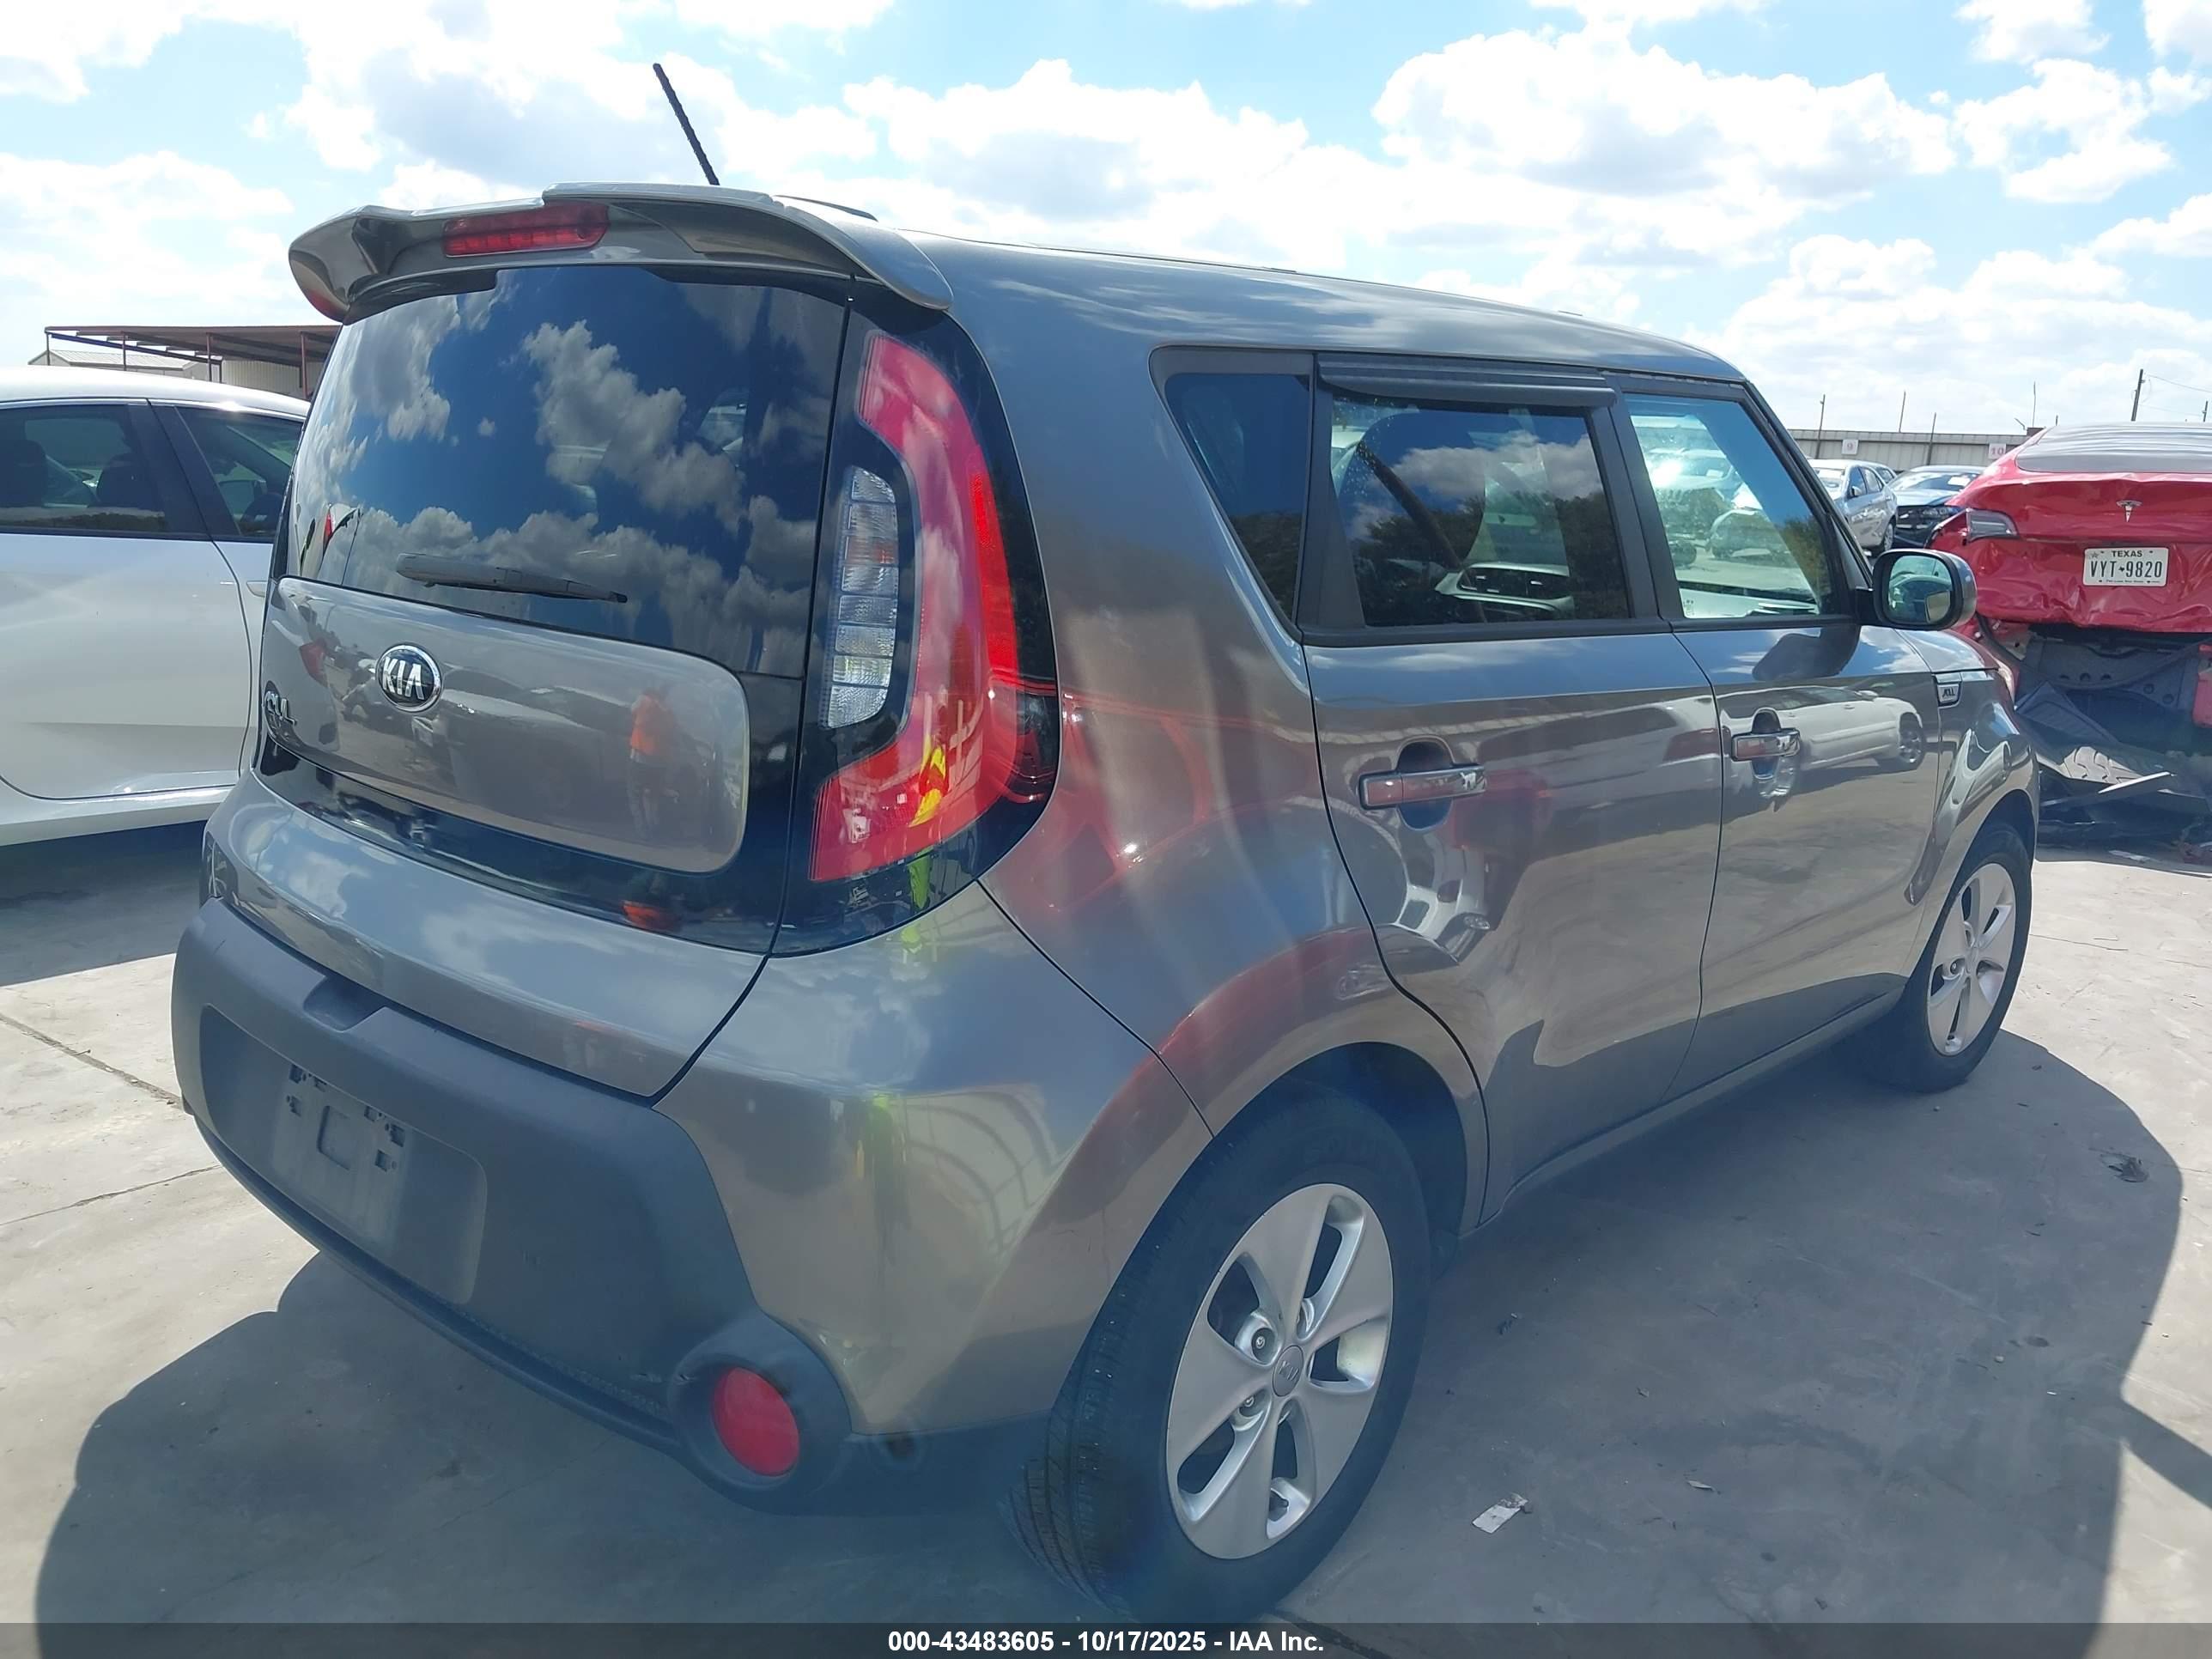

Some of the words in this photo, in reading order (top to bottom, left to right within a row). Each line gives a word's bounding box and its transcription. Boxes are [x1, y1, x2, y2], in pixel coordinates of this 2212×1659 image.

[1991, 447, 2005, 456] 10
[2091, 561, 2117, 578] VYT
[2125, 561, 2162, 578] 9820
[382, 656, 425, 701] KIA
